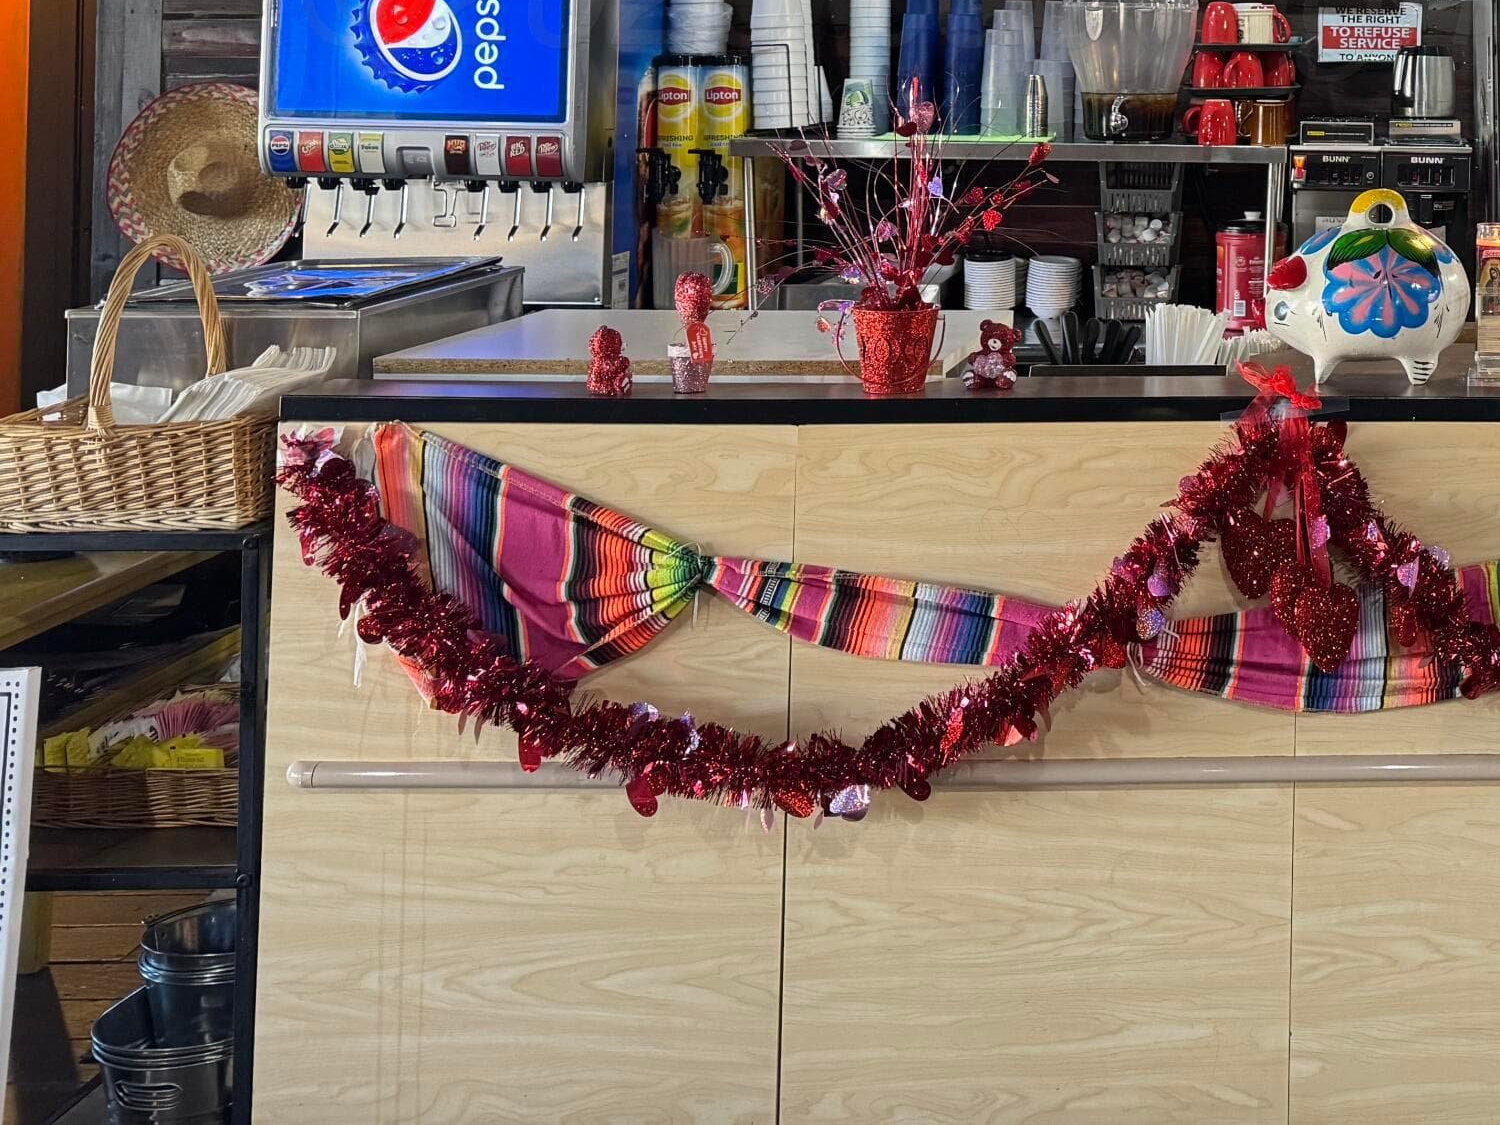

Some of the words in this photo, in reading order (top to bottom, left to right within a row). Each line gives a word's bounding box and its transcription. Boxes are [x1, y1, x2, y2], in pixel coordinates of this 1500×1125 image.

[1335, 7, 1355, 15] WE
[1357, 7, 1407, 16] RESERVE
[1340, 15, 1364, 24] THE
[1366, 16, 1402, 24] RIGHT
[1330, 26, 1350, 37] TO
[1354, 27, 1410, 38] REFUSE
[1339, 38, 1400, 49] SERVICE
[1340, 53, 1354, 61] TO
[1357, 53, 1394, 61] ANYON
[706, 91, 739, 102] Lipton
[1322, 155, 1349, 163] BUNN
[1410, 156, 1443, 164] BUNN
